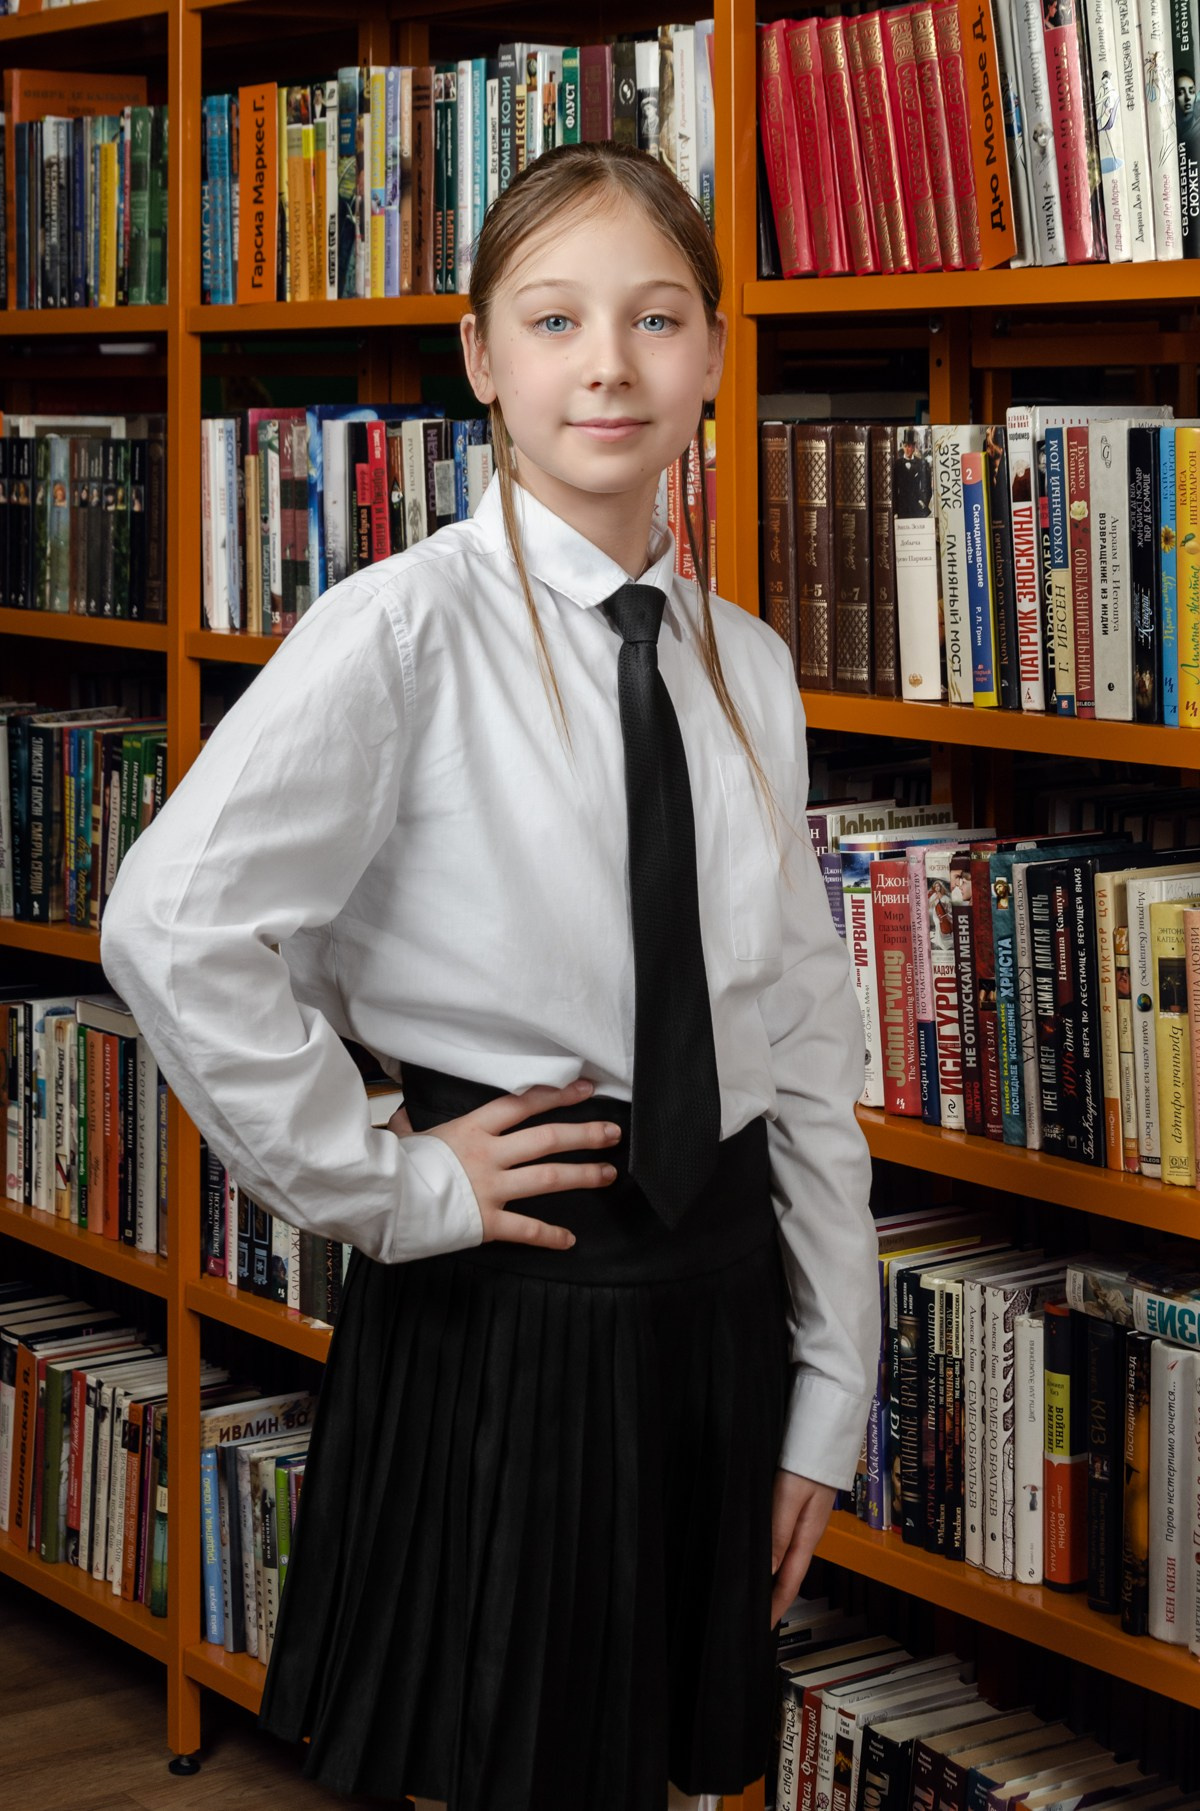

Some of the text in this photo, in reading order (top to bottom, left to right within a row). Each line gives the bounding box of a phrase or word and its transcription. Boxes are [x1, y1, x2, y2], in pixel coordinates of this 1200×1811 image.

[490, 117, 498, 155] уезжают
[501, 76, 511, 192] РОМЫЕ КОНИ
[566, 83, 575, 128] ФАУСТ
[972, 5, 1006, 232] Дю Морье Д.
[251, 95, 266, 289] Гарсиа Маркес Г.
[1043, 195, 1057, 241] Кукла
[1110, 179, 1123, 251] Дафна Дю Морье
[1131, 160, 1145, 243] Дафна Дю Морье
[1178, 142, 1189, 236] СВАДЕБНЫЙ
[1188, 158, 1200, 217] СЮЖЕТ
[435, 211, 443, 270] О.ГЕНРИ
[446, 209, 455, 270] О.ГЕНРИ
[938, 445, 951, 510] ЗУСАК
[950, 443, 962, 509] МАРКУС
[965, 468, 973, 481] 2
[1048, 439, 1064, 563] КУКОЛЬНЫЙ ДОМ
[1068, 440, 1079, 495] Ибаньес
[1077, 445, 1088, 489] Бласко
[1143, 473, 1151, 512] БОМАРШЕ
[1179, 470, 1187, 506] КАЙСА
[1189, 450, 1198, 525] ИНГЕМАРСОН
[359, 509, 370, 534] буква
[359, 536, 369, 559] Алая
[965, 531, 974, 563] мифы
[973, 504, 985, 588] Скандинавские
[1145, 514, 1152, 523] ДЕ
[945, 534, 963, 677] ГЛИНЯНЫЙ МОСТ
[1012, 506, 1039, 682] ПАТРИК ЗЮСКИНД
[1042, 533, 1058, 669] ПАРФЮМЕР
[1098, 513, 1109, 636] ВОЗВРАЩЕНИЕ ИЗ ИНДИИ
[1110, 515, 1121, 633] Авраам Б. Иегошуа
[976, 606, 982, 614] Р.
[976, 616, 982, 625] Л.
[1055, 584, 1069, 673] Г. ИБСЕН
[1074, 548, 1092, 691] СОБЛАЗНИТЕЛЬНИЦА
[131, 761, 139, 819] ДЕКАМЕРОН
[155, 755, 164, 806] лесам
[876, 874, 909, 888] Джон
[1073, 867, 1083, 893] ВНИЗ
[849, 894, 869, 967] ИРВИНГ
[884, 911, 904, 922] Мир
[912, 872, 928, 1015] ПО СЧАСТЛИВОМУ ЗАМУЖЕСТВУ
[1053, 885, 1069, 981] Наташа Кампуш
[1075, 896, 1086, 945] ВЕДУЩЕЙ
[1032, 894, 1056, 1016] САМАЯ ДОЛГАЯ НОЧЬ
[1095, 888, 1112, 1014] Я ВИКТОР ЦОЙ
[882, 950, 905, 1087] John Irving
[905, 962, 916, 1082] The World According to Garp
[957, 914, 978, 1068] НЕ ОТПУСКАЙ МЕНЯ
[1017, 965, 1035, 1065] КАВАБАТА
[1081, 1011, 1090, 1023] ПО
[933, 976, 964, 1096] ИСИГУРО
[997, 937, 1021, 1116] ПОСЛЕДНЕЕ ИСКУШЕНИЕ ХРИСТА
[999, 1002, 1012, 1115] НИКОС КАЗАНДЗАКИС
[1062, 1017, 1078, 1099] 3096 дней
[1081, 1027, 1091, 1058] ВВЕРХ
[919, 1030, 929, 1101] Софи Ирвин
[984, 1020, 999, 1116] ФИЛИП КАЗАН
[1039, 1045, 1058, 1112] ГРЕГ КАЙЗЕР
[1170, 1025, 1184, 1145] Брачный офицер
[972, 1081, 981, 1124] ИСИГУРО
[137, 1060, 146, 1244] МАРИО ВАРГАС ЛЬОСА
[1147, 1298, 1158, 1332] КЕН
[927, 1303, 936, 1431] ПРИЗРАК ГРЯДУЩЕГО
[947, 1349, 954, 1365] ПО
[899, 1354, 919, 1486] ТАЙНЫЕ ВРАТА
[946, 1367, 954, 1416] ДЕВУШКИ
[1125, 1355, 1138, 1461] Последний заезд
[14, 1366, 31, 1529] Вишневский Я.
[219, 1417, 279, 1443] ИВЛИН
[967, 1379, 977, 1510] СЕМЕРО БРАТЬЕВ
[988, 1387, 999, 1518] СЕМЕРО БРАТЬЕВ
[1054, 1407, 1066, 1450] ВОЙНЫ
[202, 1477, 212, 1505] только
[1164, 1438, 1177, 1504] нестерпимо
[936, 1503, 946, 1537] Machaon
[953, 1507, 962, 1541] Machaon
[1049, 1510, 1058, 1573] МИЛЛИГАНА
[1057, 1512, 1067, 1550] ВОЙНЫ
[1164, 1505, 1178, 1543] Порою
[1166, 1556, 1176, 1624] КЕН КИЗИ
[782, 1697, 797, 1795] снова Париж!
[801, 1705, 817, 1776] Францию!
